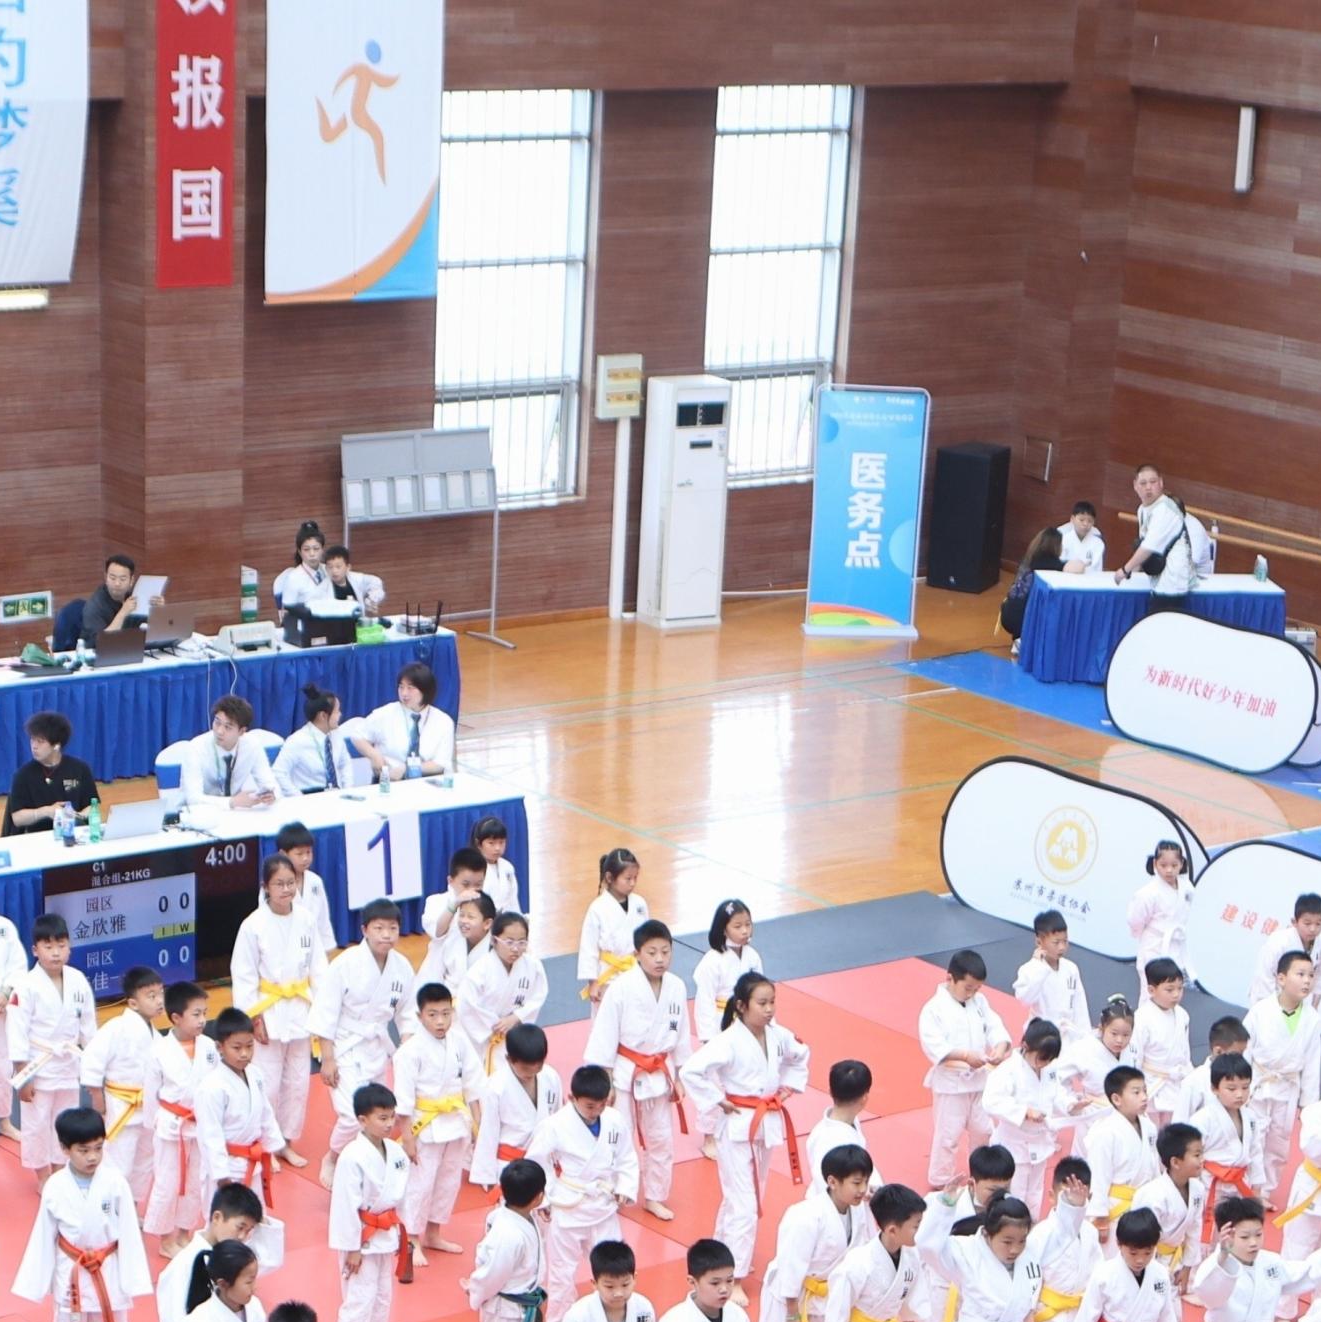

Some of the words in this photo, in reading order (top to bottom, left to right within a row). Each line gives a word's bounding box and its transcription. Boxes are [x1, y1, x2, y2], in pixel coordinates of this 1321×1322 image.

[171, 0, 226, 240] 报国
[845, 452, 887, 568] 医务点
[1144, 665, 1278, 718] 为新时代好少年加油
[205, 843, 246, 867] 4:00
[367, 820, 393, 896] 1
[92, 862, 106, 873] C1
[86, 894, 113, 913] 园区
[158, 895, 169, 913] 0
[180, 891, 190, 910] 0
[73, 914, 127, 940] 金欣雅
[180, 923, 190, 933] W
[86, 949, 114, 969] 园区
[158, 949, 169, 967] 0
[180, 945, 190, 964] 0
